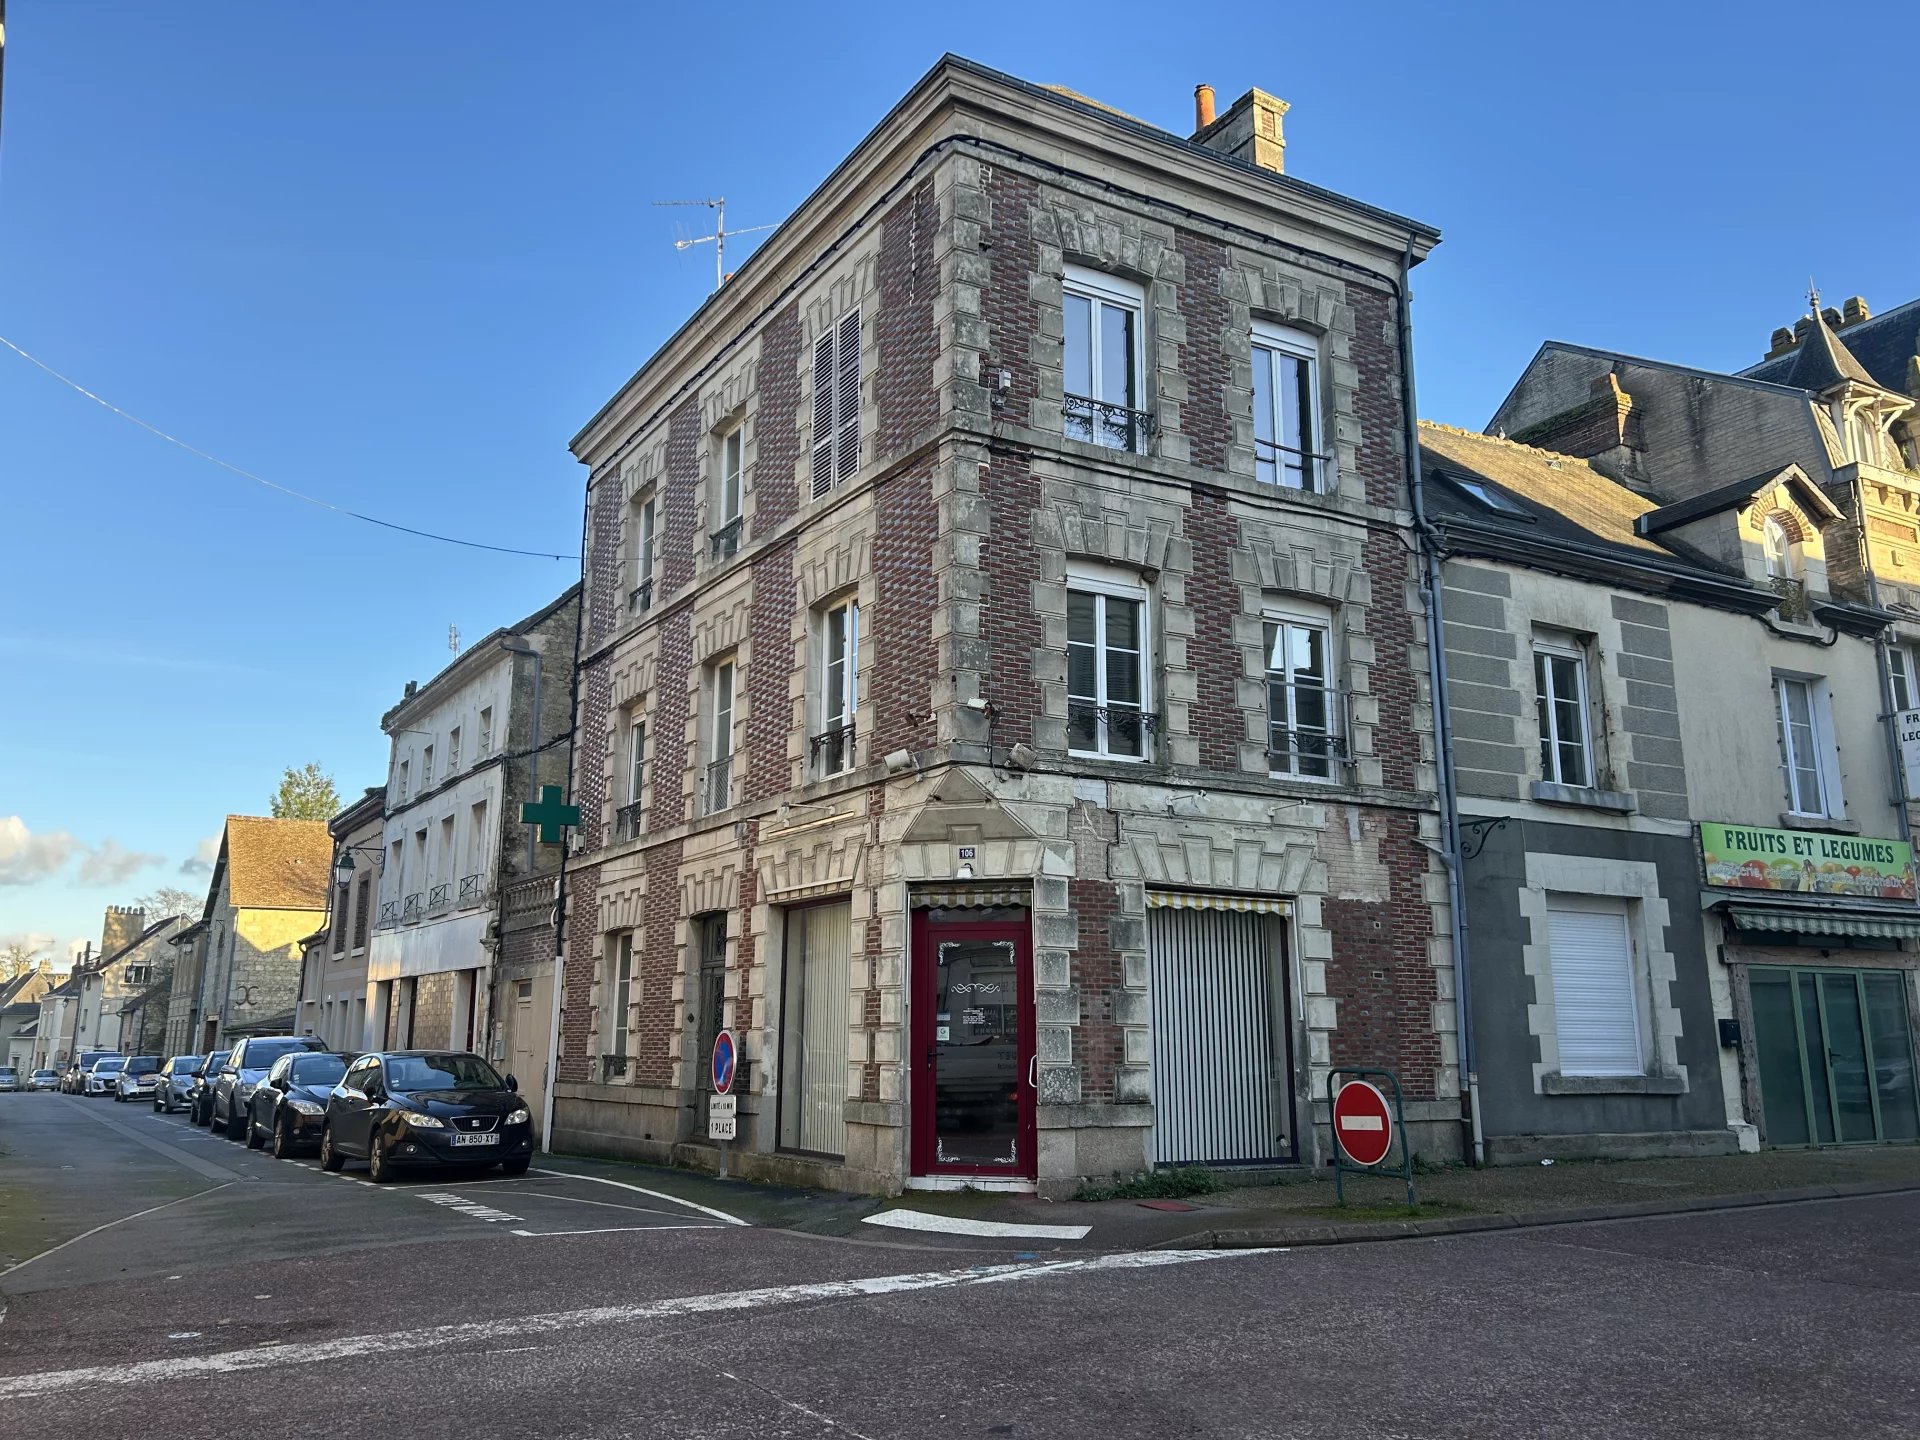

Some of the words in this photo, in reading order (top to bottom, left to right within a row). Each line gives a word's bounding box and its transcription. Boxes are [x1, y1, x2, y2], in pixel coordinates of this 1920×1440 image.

[1724, 829, 1787, 854] FRUITS
[1793, 836, 1814, 856] ET
[1820, 838, 1895, 864] LEGUMES
[960, 849, 974, 858] 106
[715, 1122, 732, 1134] PLACE
